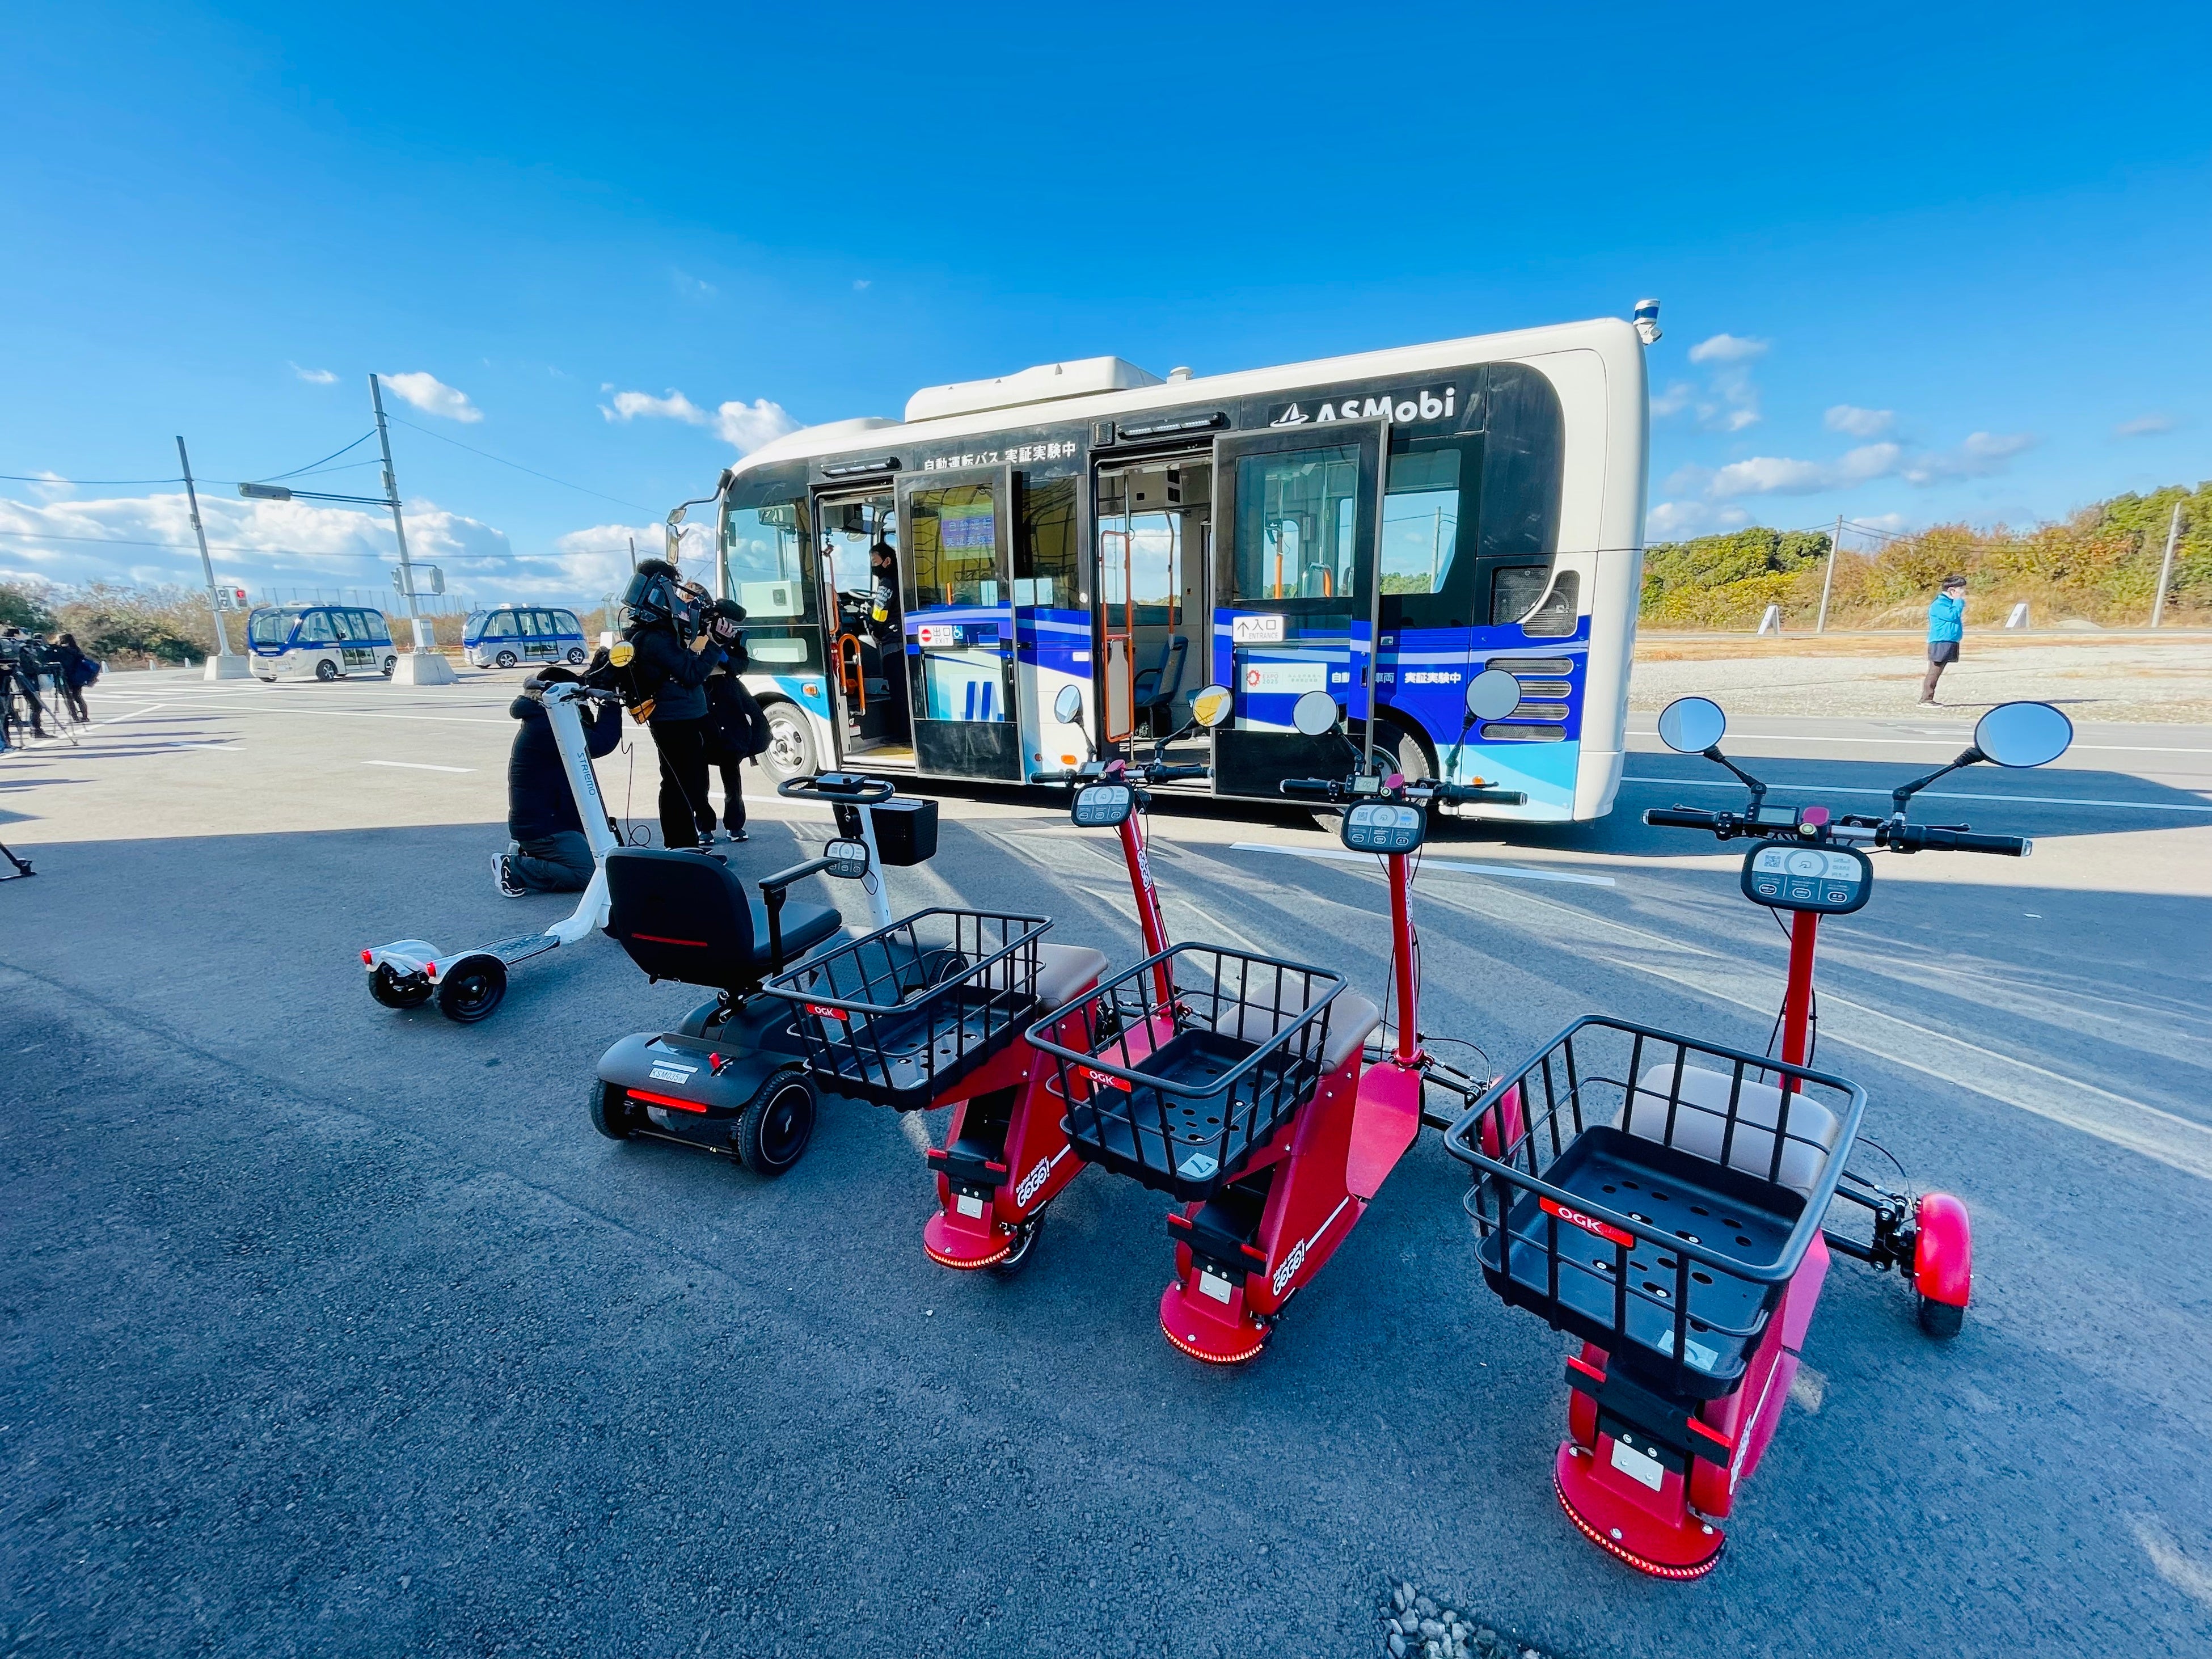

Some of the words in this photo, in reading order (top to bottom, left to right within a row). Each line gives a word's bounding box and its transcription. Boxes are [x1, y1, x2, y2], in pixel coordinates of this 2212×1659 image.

[1316, 387, 1455, 424] ASMobi
[924, 451, 998, 471] 自動運転バス
[1004, 440, 1077, 464] 実証実験中
[933, 627, 951, 636] 出口
[1252, 619, 1276, 631] 入口
[1404, 672, 1462, 684] 実証実験中
[814, 1006, 834, 1017] OGK
[1089, 1070, 1115, 1086] OGK
[1017, 1160, 1050, 1208] GOGO!
[1558, 1206, 1603, 1233] OGK
[1273, 1243, 1306, 1296] GOGO!
